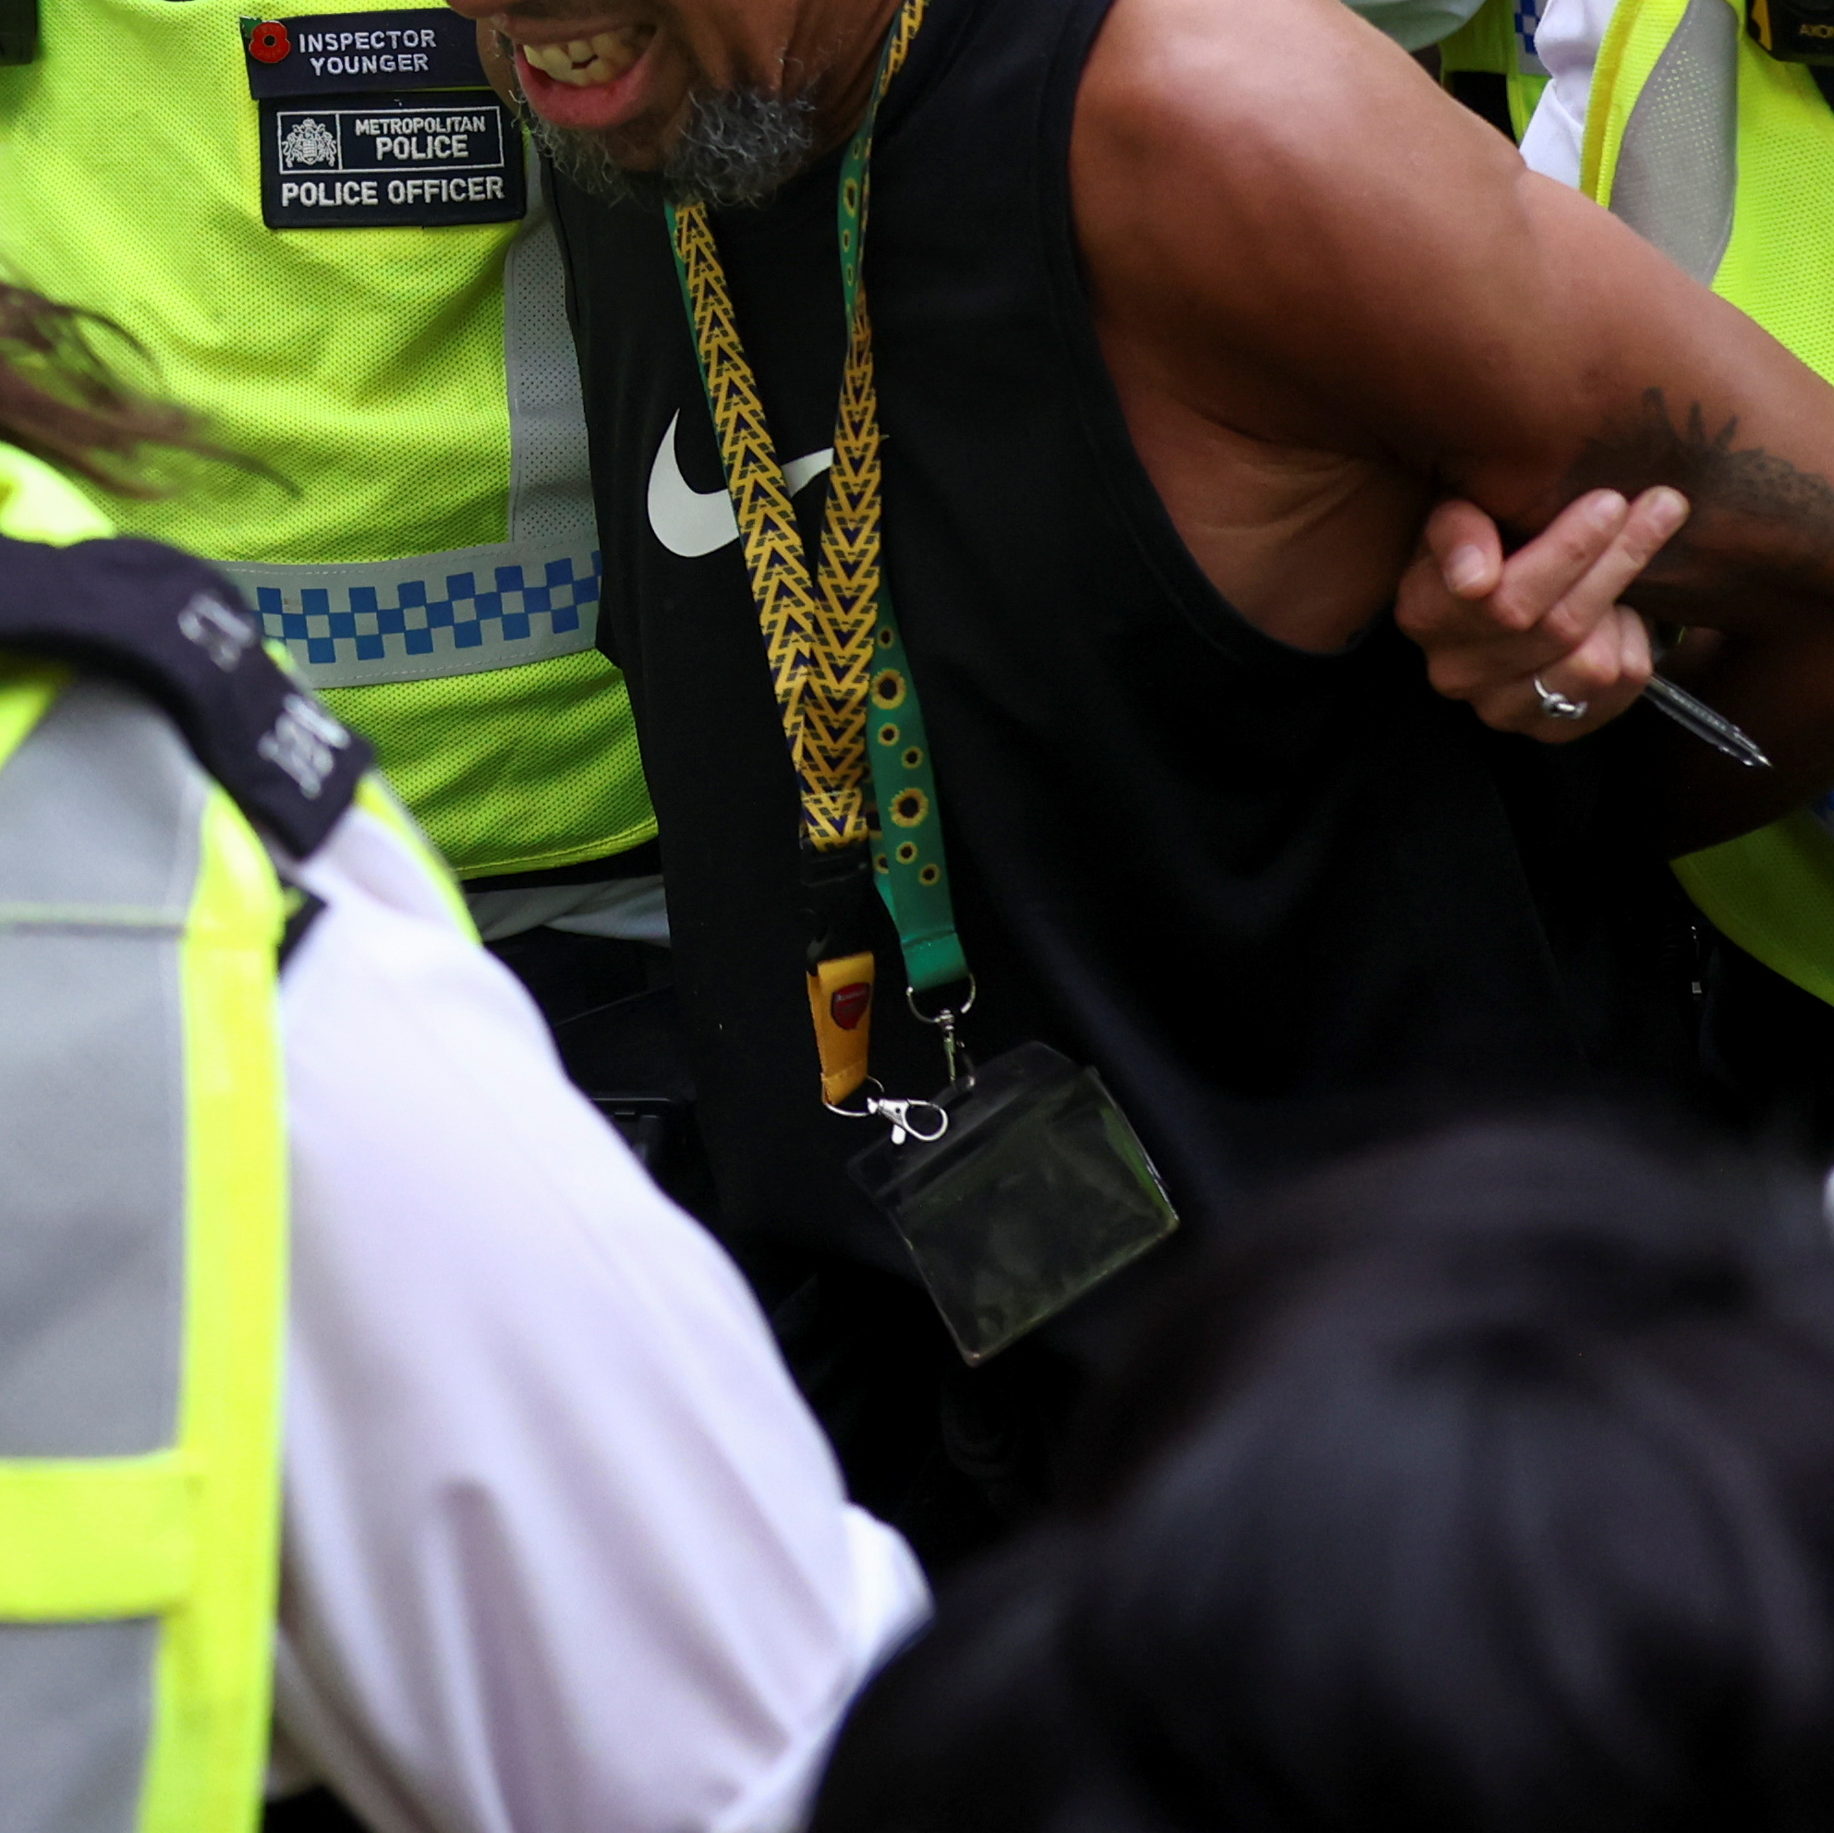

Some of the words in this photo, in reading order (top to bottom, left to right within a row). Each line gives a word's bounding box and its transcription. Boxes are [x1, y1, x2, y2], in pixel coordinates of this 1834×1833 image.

[298, 29, 437, 54] INSPECTOR
[309, 53, 430, 76] YOUNGER
[354, 115, 487, 136] METROPOLITAN
[375, 134, 469, 161] POLICE
[281, 180, 379, 208] POLICE
[387, 176, 506, 205] OFFICER
